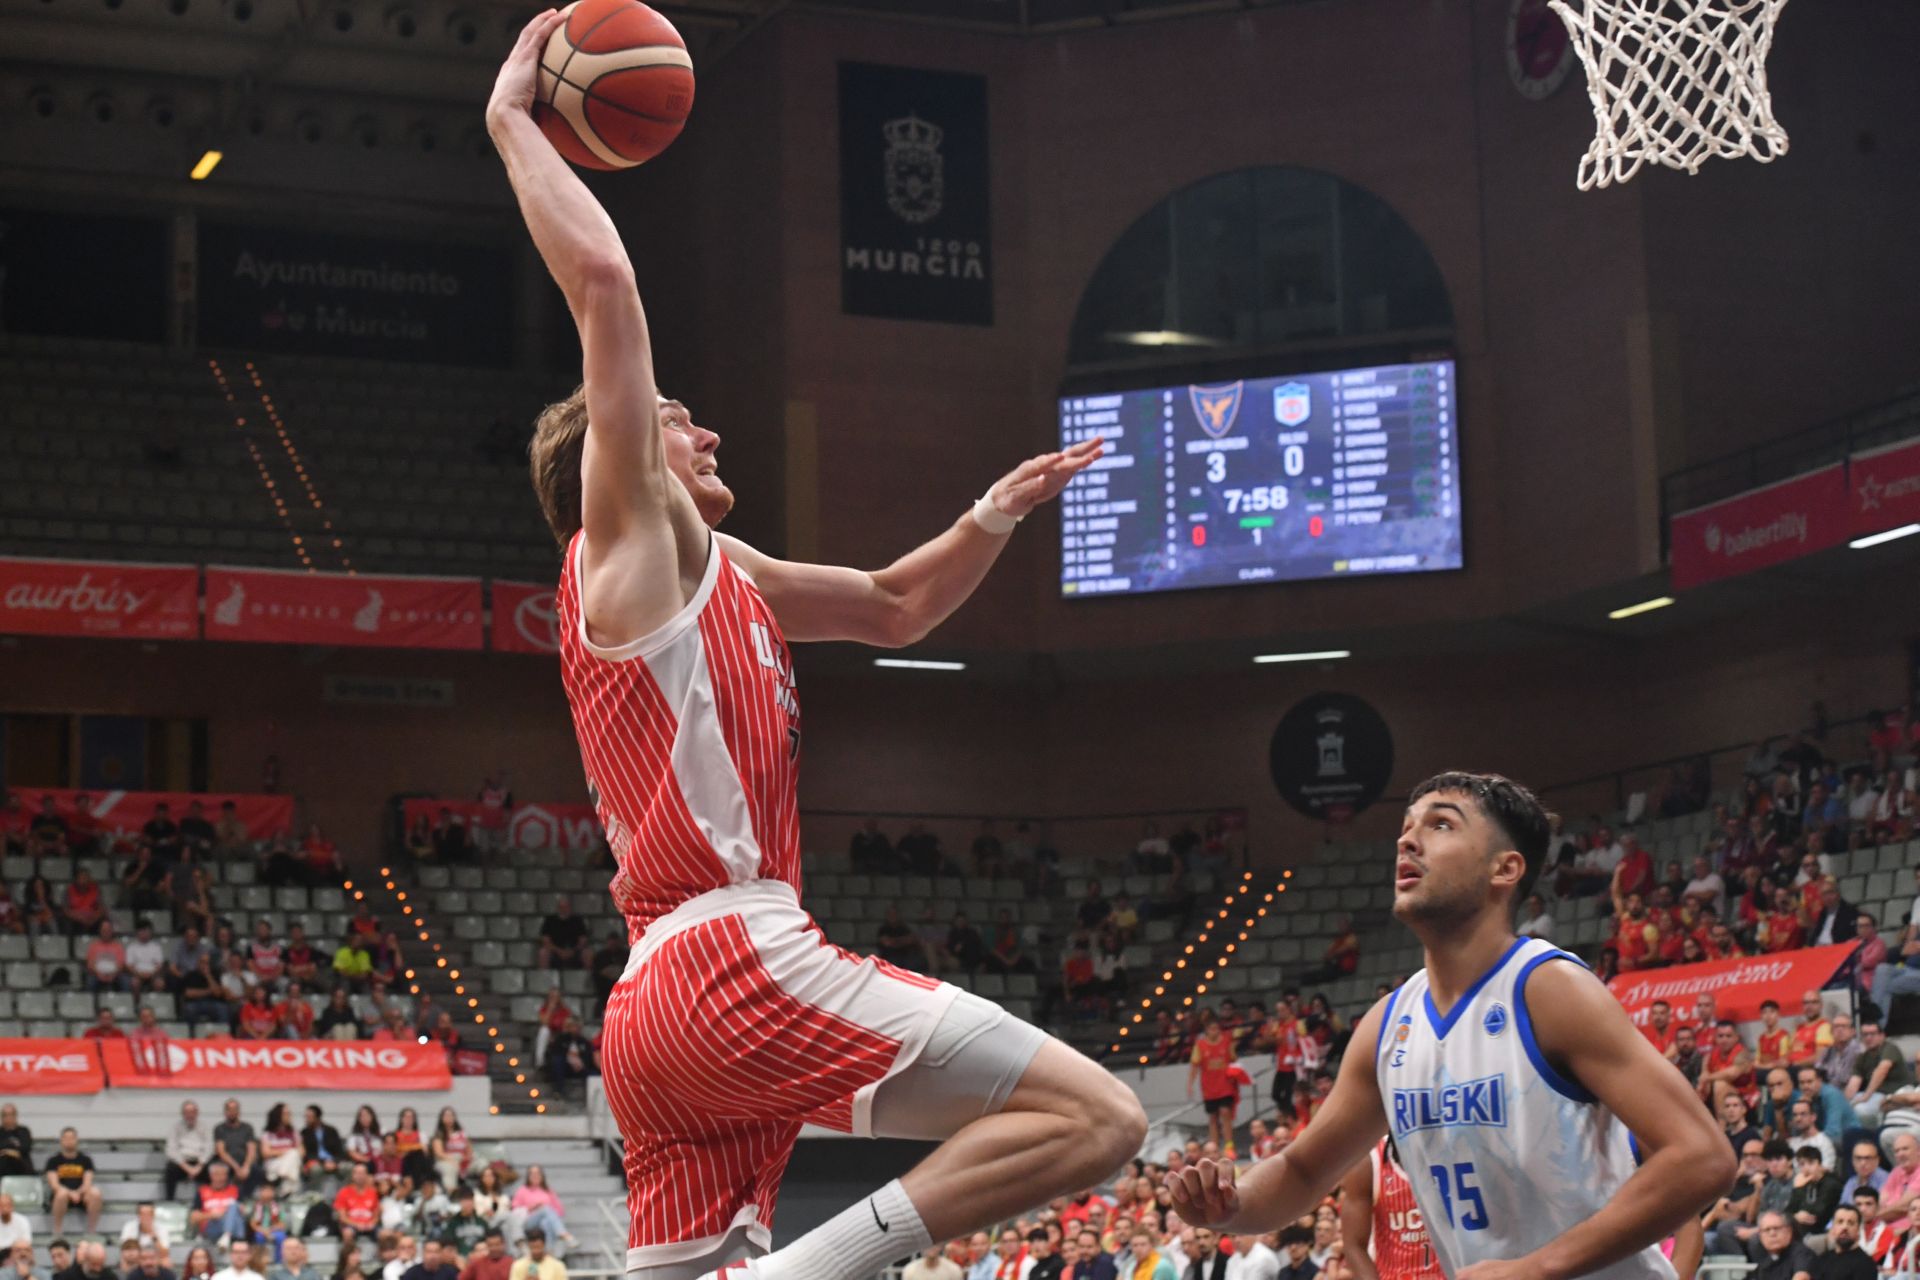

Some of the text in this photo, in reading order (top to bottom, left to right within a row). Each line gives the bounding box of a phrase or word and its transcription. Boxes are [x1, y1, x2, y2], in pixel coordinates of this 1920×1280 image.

[232, 251, 460, 297] Ayuntamiento
[846, 247, 985, 280] MURCIA
[315, 304, 430, 340] Murcia
[1206, 451, 1227, 484] 3
[1283, 444, 1305, 477] 0
[1222, 484, 1289, 514] 7:58
[1252, 527, 1262, 546] 1
[192, 1046, 408, 1070] INMOKING
[1392, 1074, 1507, 1138] RILSKI
